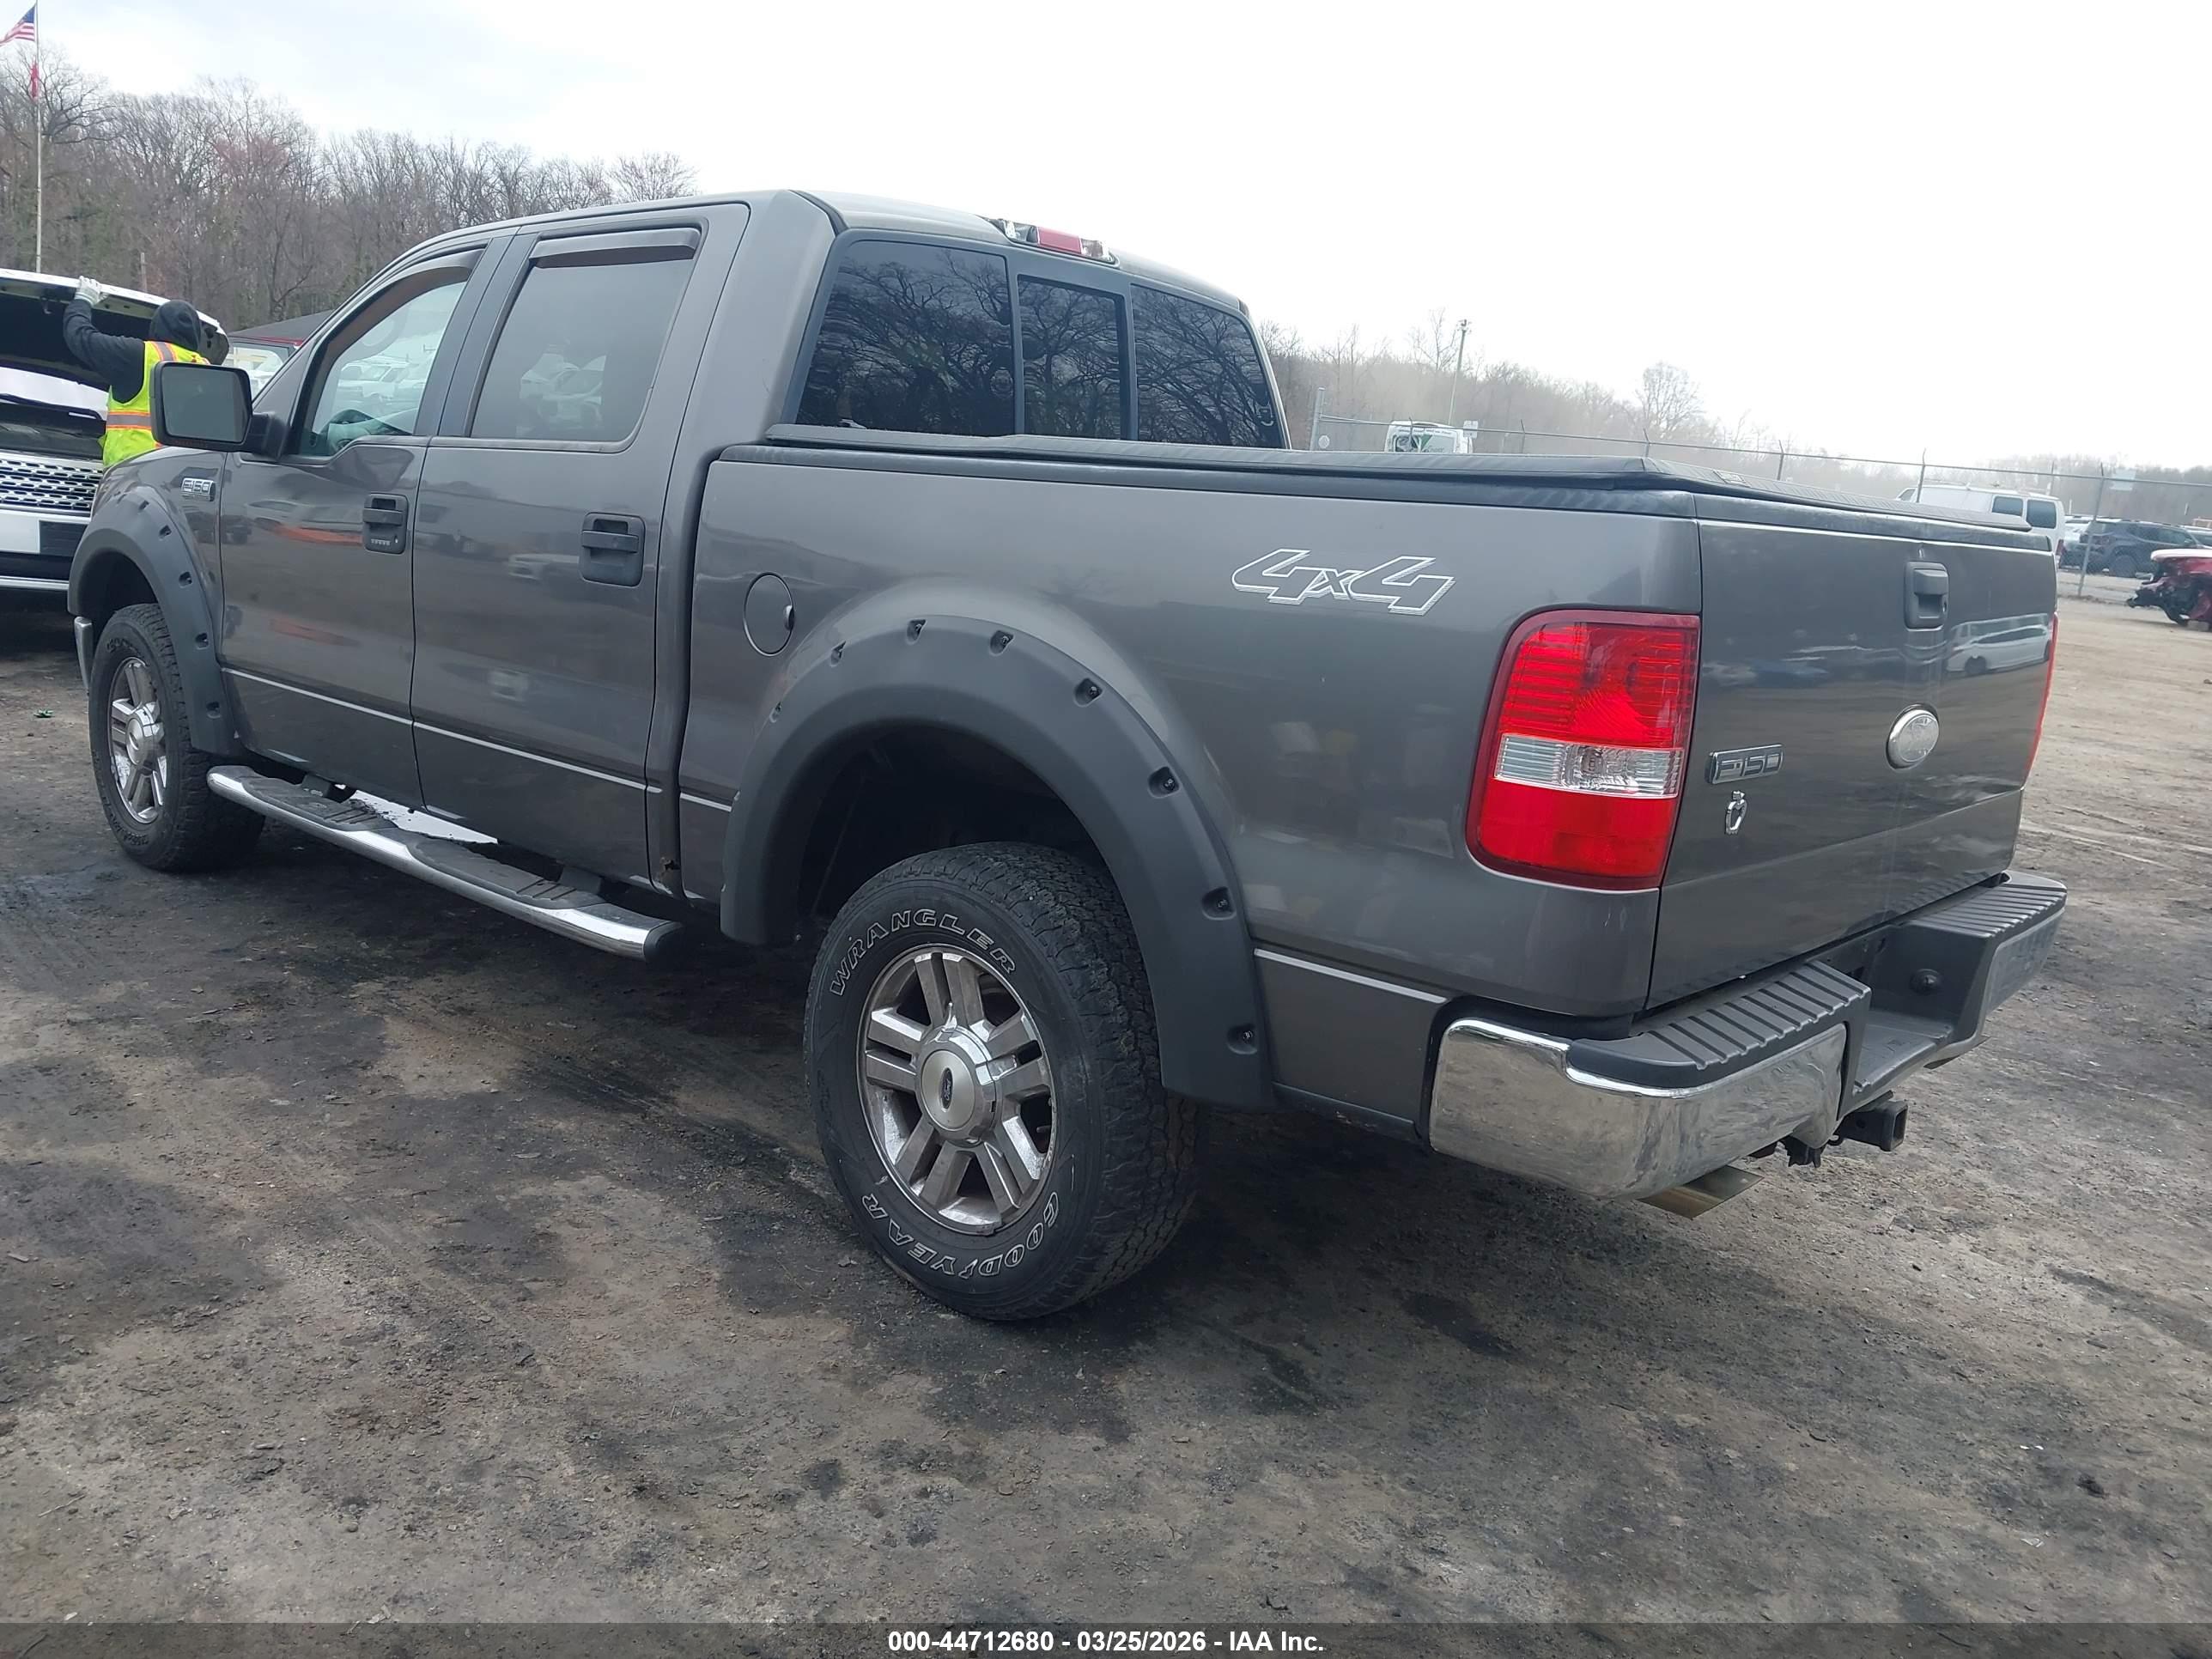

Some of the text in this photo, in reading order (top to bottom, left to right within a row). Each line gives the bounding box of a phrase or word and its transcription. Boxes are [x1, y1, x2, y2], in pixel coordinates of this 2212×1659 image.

[1231, 549, 1455, 616] 4x4
[830, 908, 1017, 996] WRANGLER
[861, 1191, 1059, 1279] GOODYEAR
